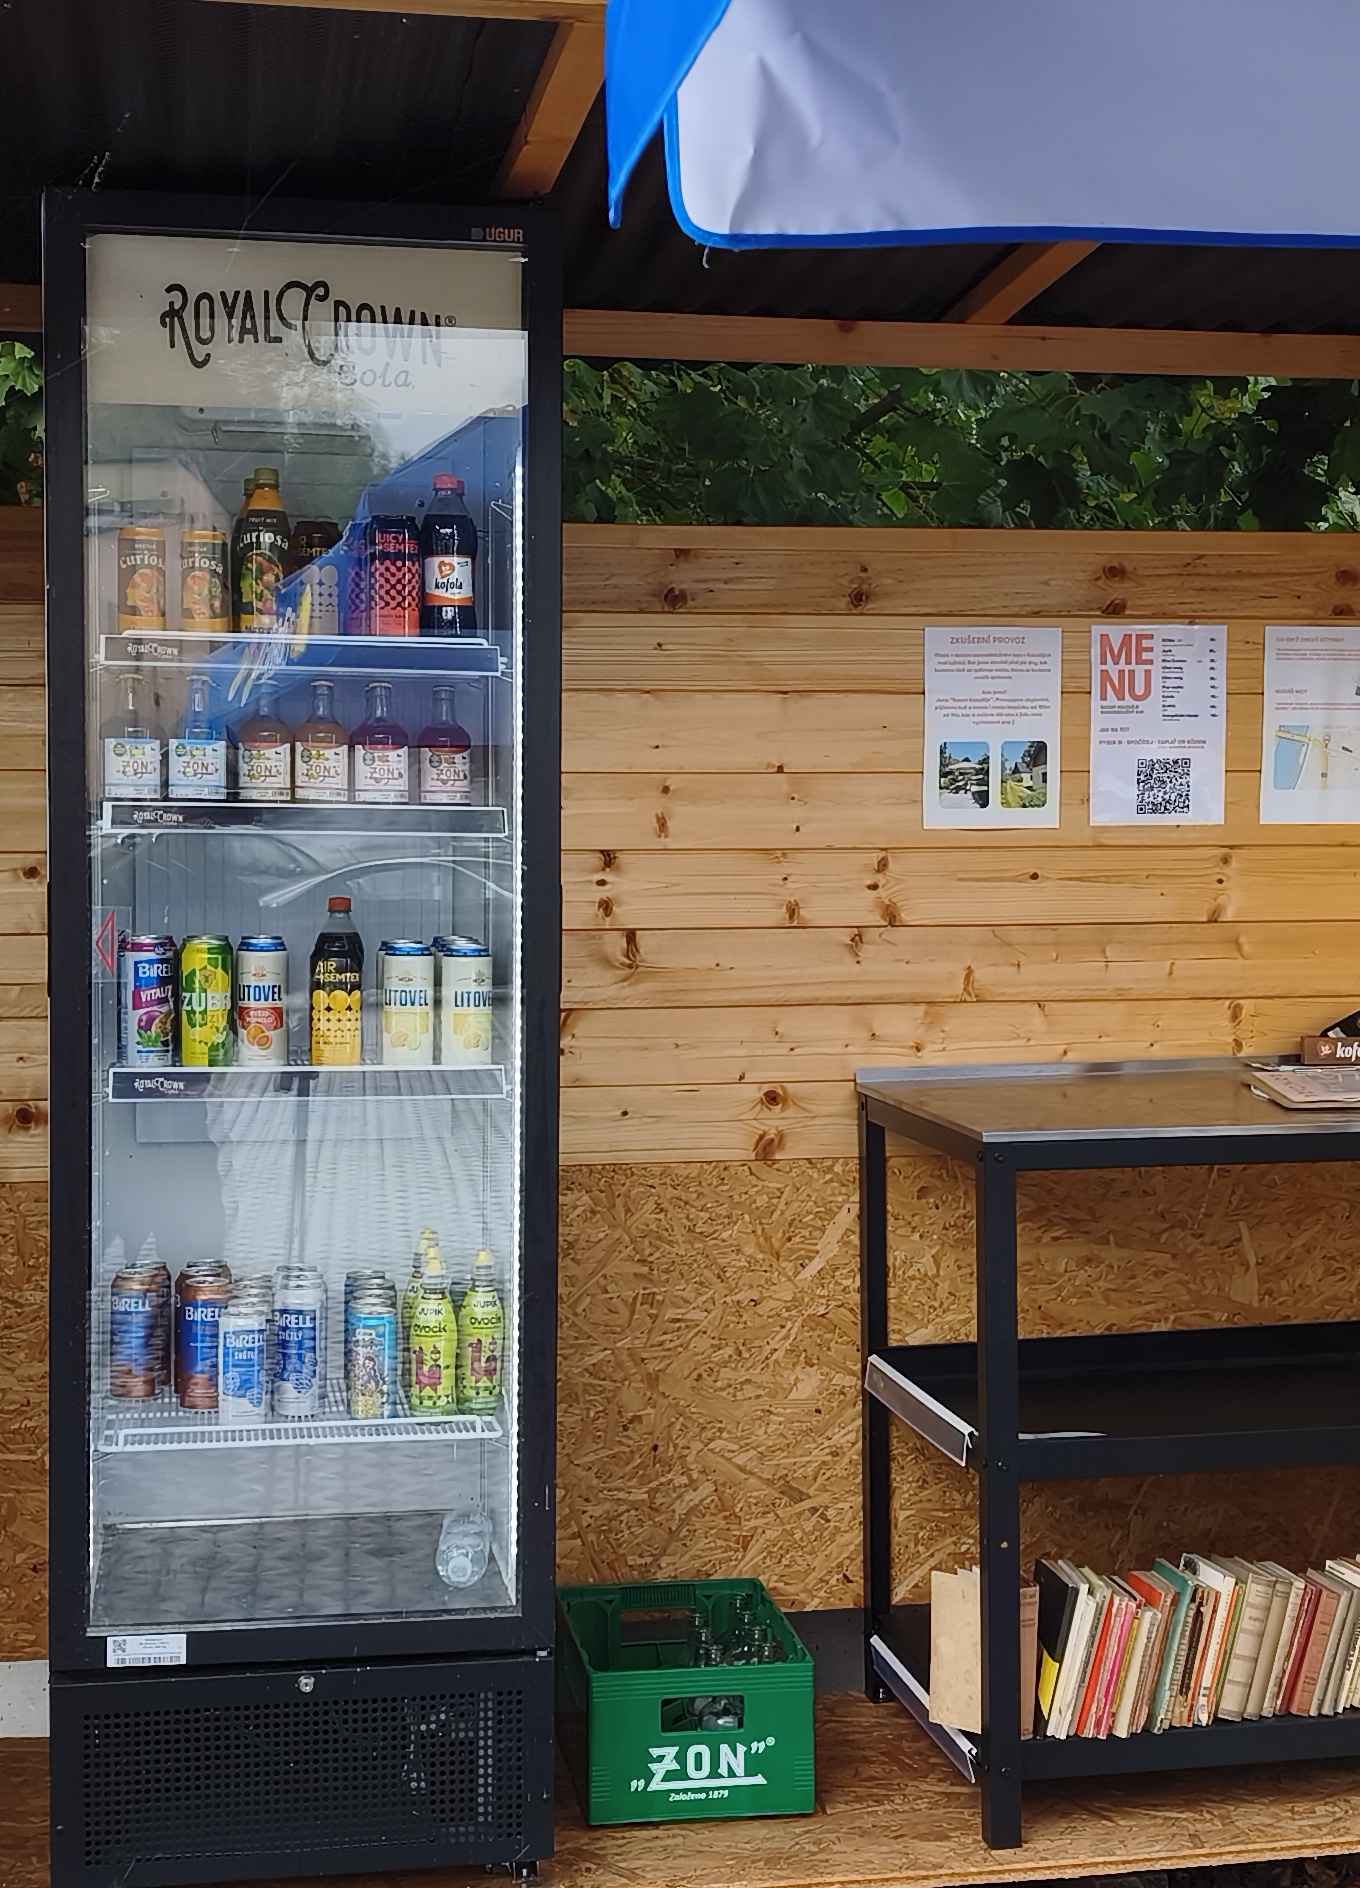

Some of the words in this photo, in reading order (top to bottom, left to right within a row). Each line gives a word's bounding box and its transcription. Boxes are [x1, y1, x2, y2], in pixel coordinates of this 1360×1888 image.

[160, 283, 285, 369] ROYAL
[239, 527, 289, 550] curiosa
[119, 551, 166, 570] curios
[434, 577, 463, 593] kofola
[993, 636, 1026, 645] PROVOZ
[1100, 633, 1154, 666] ME
[1100, 669, 1152, 702] NU
[316, 961, 337, 973] AIR
[181, 991, 231, 1011] ZUBR
[384, 989, 429, 1007] LITOVEL
[668, 1792, 706, 1802] Založeno
[707, 1789, 729, 1799] 1879
